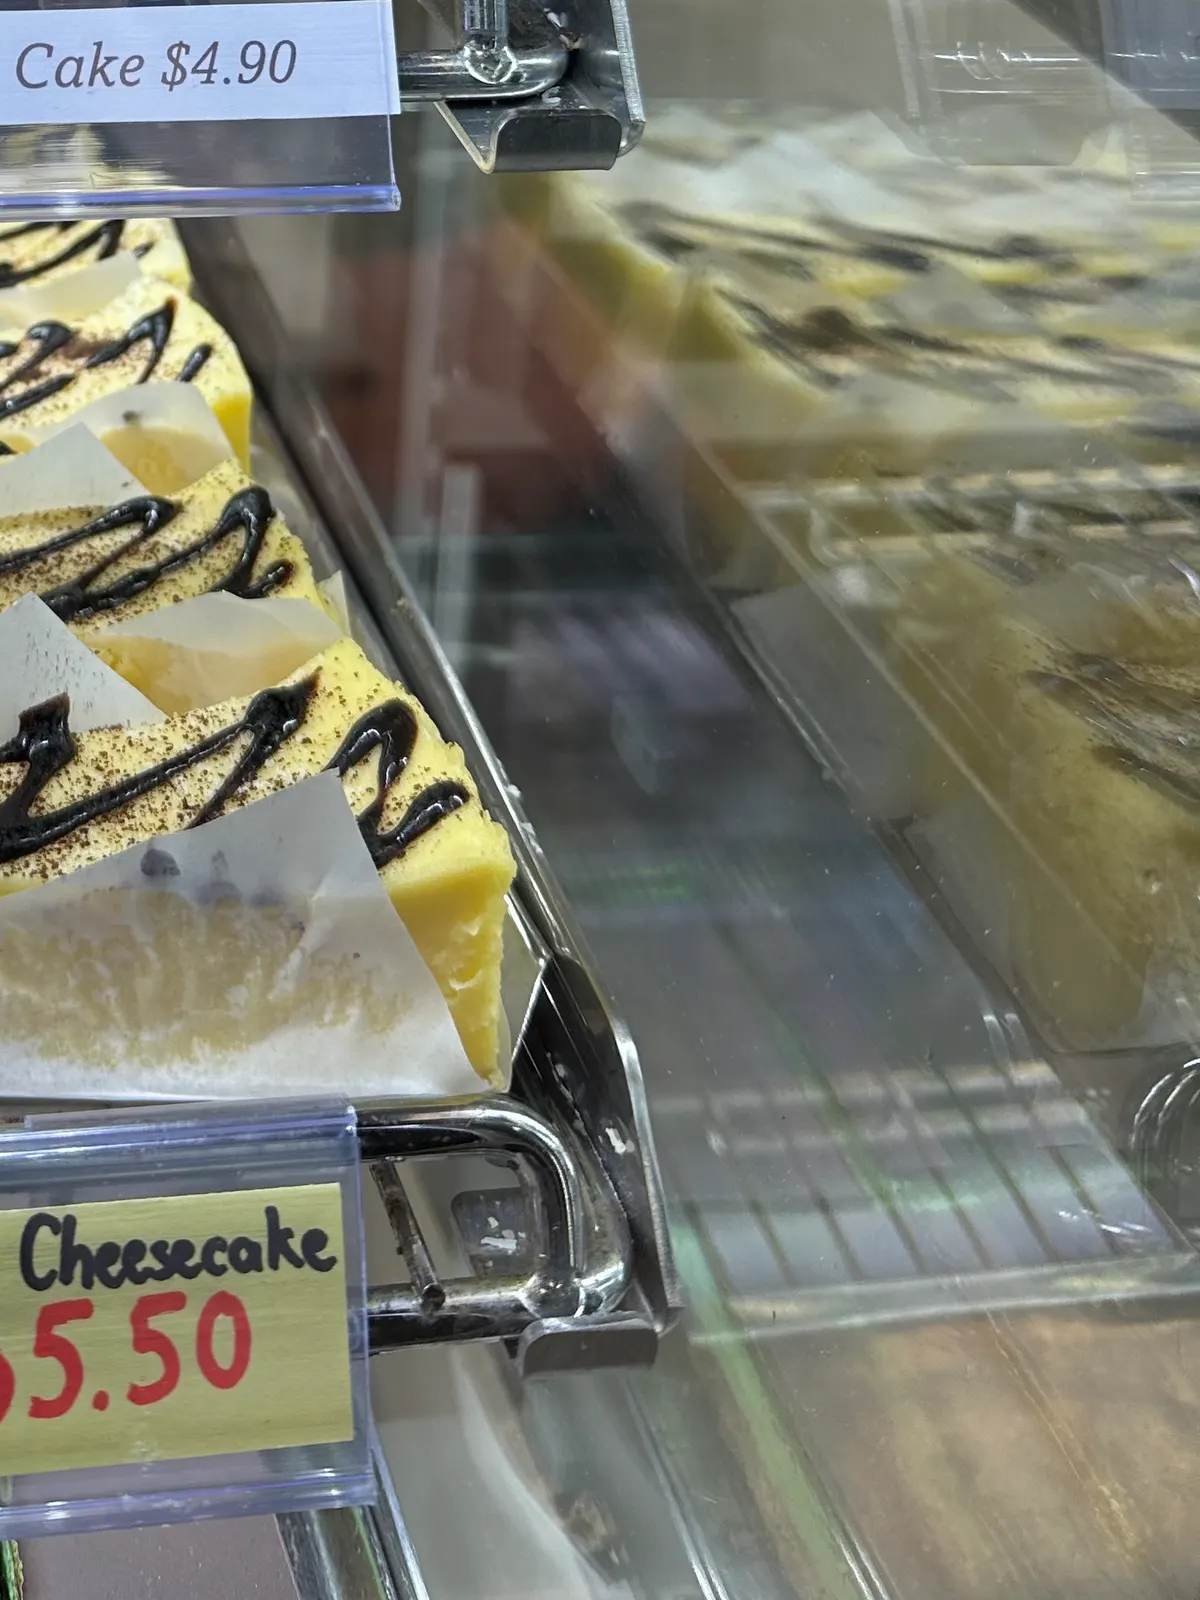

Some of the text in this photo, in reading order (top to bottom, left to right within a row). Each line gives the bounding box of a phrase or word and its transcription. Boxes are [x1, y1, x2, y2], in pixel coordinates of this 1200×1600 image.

[15, 41, 145, 90] Cake
[160, 39, 297, 92] $4.90
[18, 1205, 338, 1293] Cheesecake
